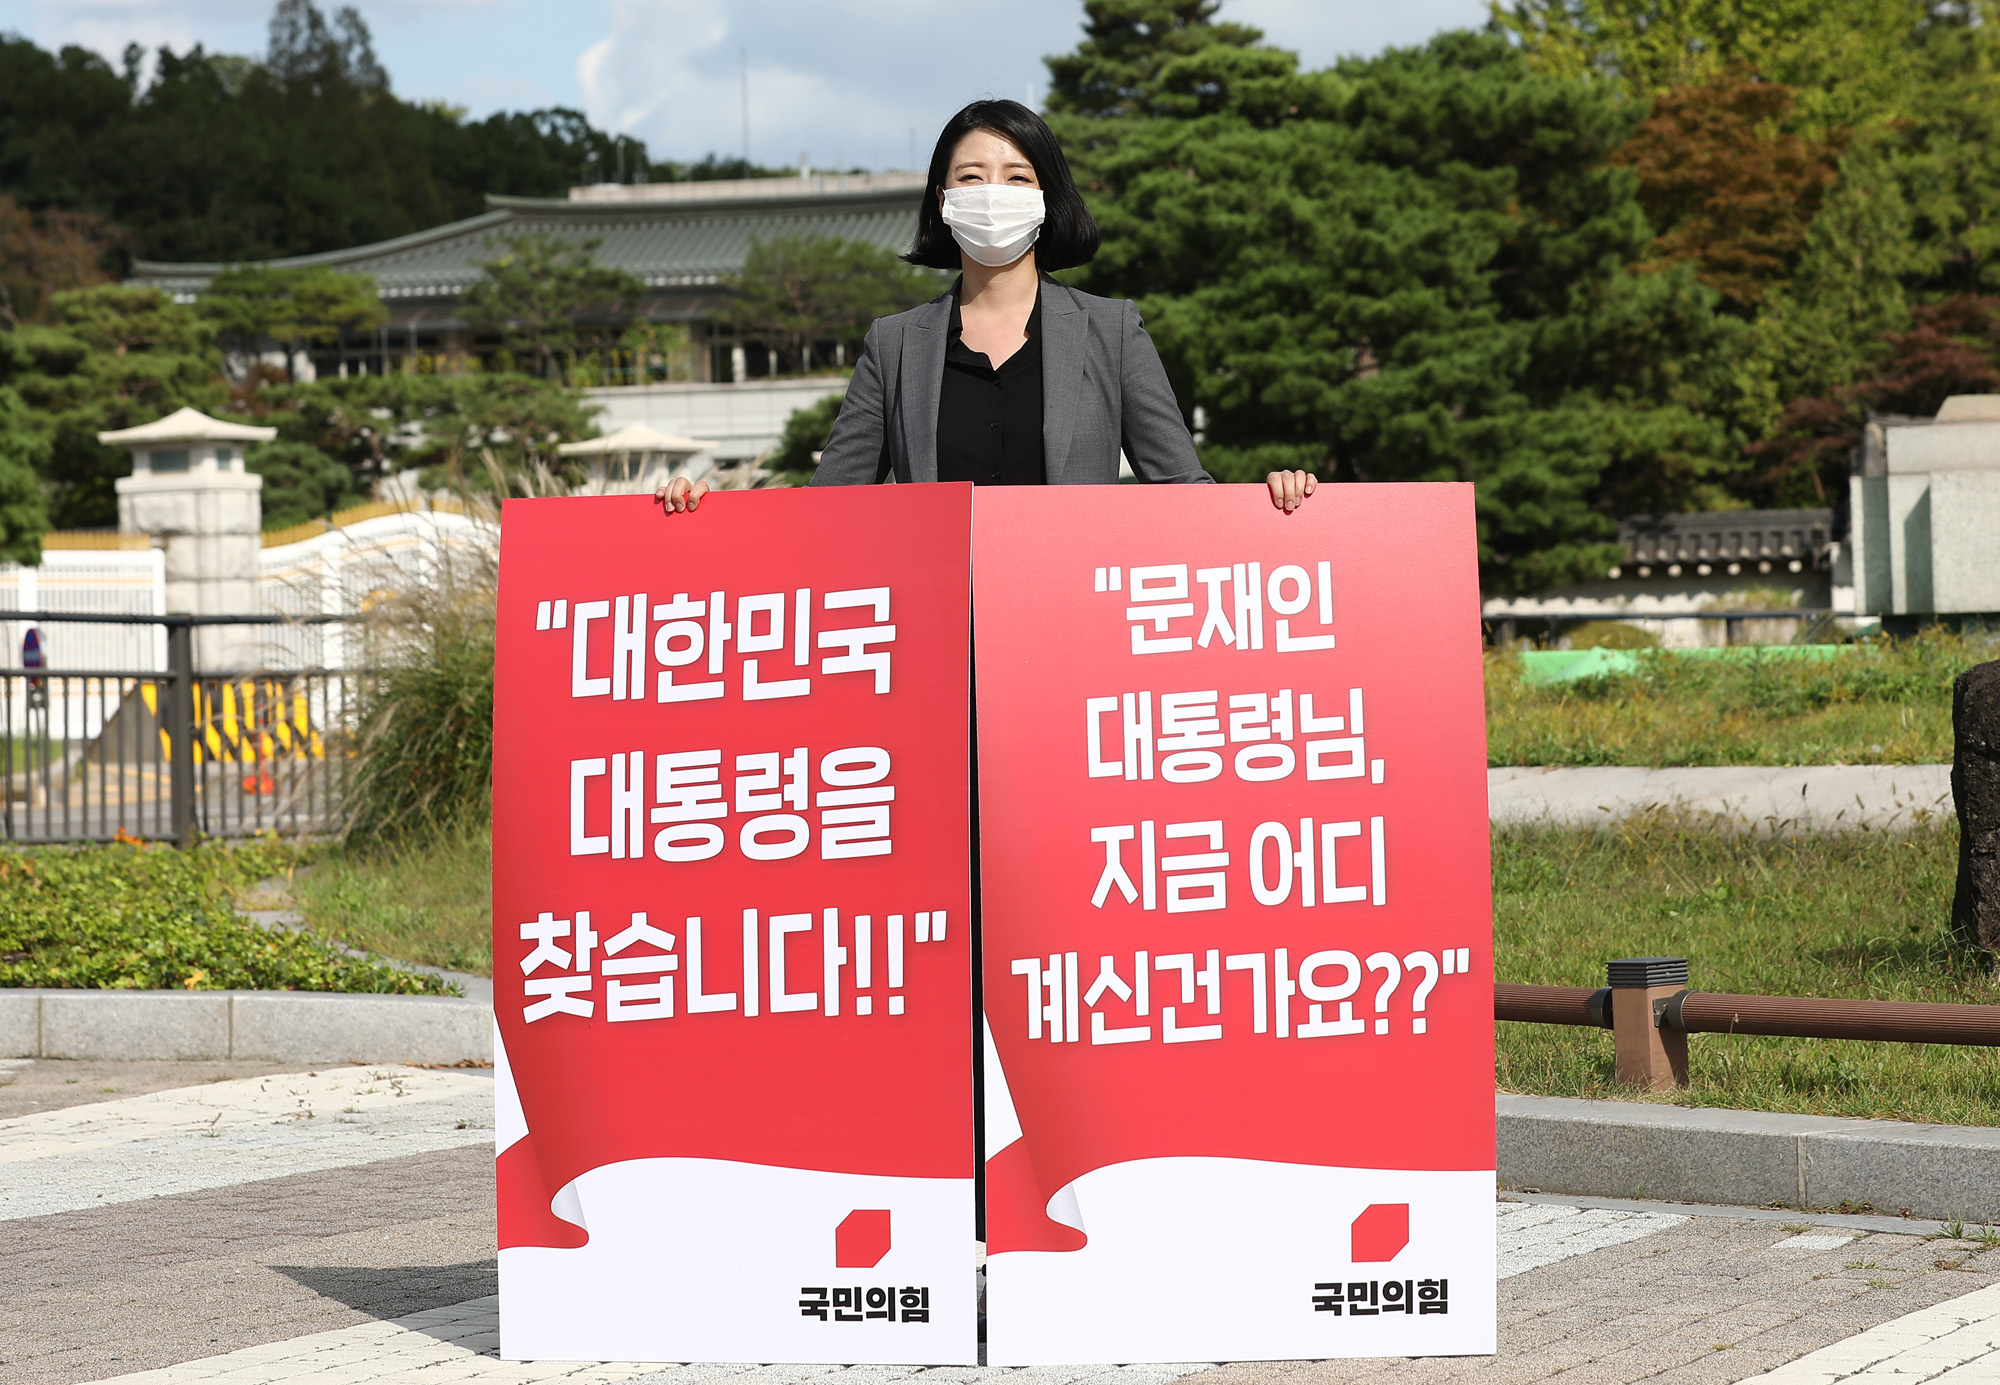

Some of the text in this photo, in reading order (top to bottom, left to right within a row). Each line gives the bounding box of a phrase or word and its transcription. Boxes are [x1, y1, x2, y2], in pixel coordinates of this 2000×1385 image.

[537, 587, 895, 703] "대한민국
[1095, 561, 1335, 655] "문재인
[1087, 688, 1384, 784] 대통령님,
[571, 747, 894, 861] 대통령을
[1091, 817, 1385, 913] 지금 어디
[520, 908, 946, 1023] 찾습니다!!"
[1012, 948, 1469, 1045] 계신건가요??"
[799, 1287, 929, 1322] 국민의힘
[1312, 1279, 1447, 1316] 국민의힘
